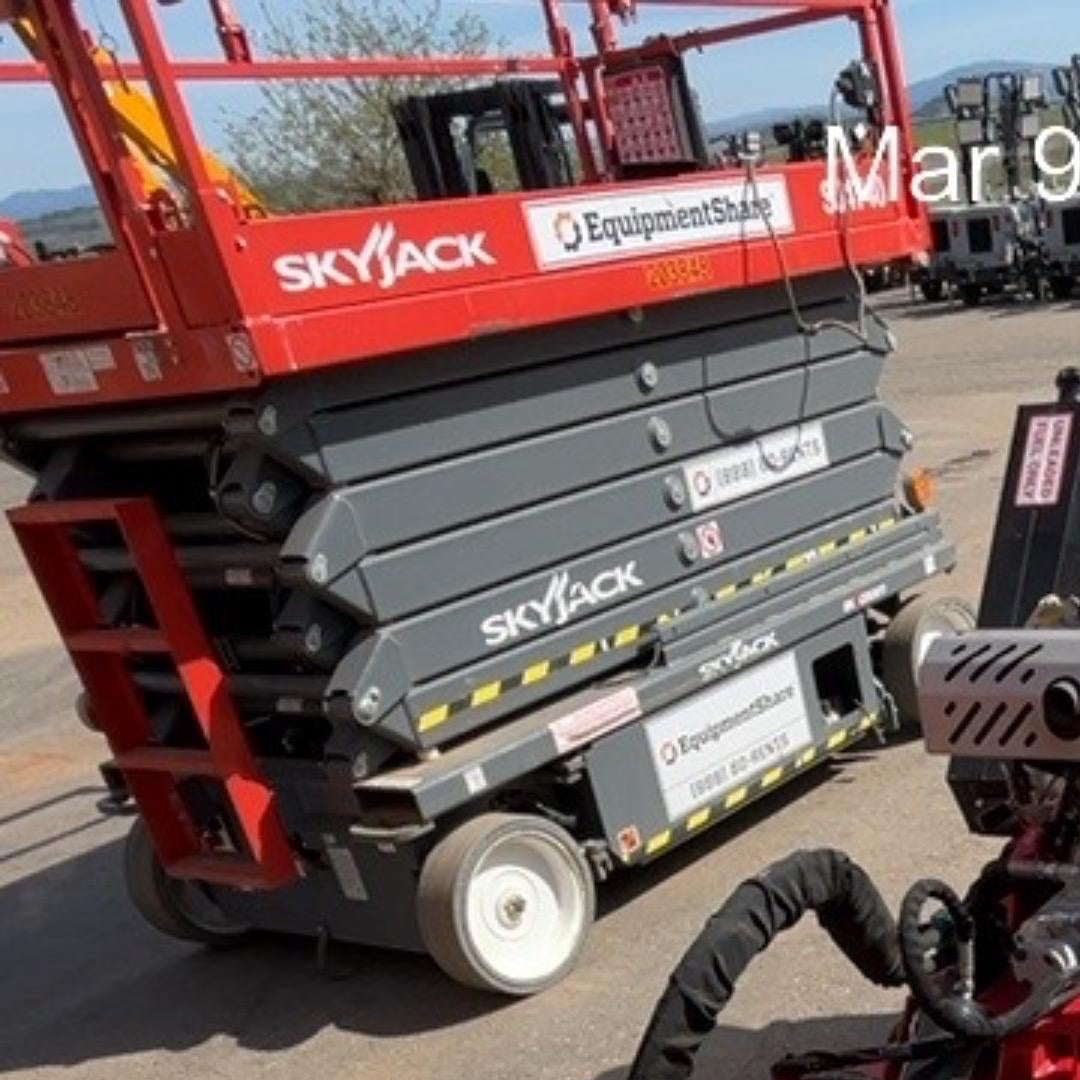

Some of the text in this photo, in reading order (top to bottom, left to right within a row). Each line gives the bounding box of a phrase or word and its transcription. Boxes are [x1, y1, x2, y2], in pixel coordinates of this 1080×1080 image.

[273, 221, 497, 293] SKYJACK
[582, 196, 774, 247] EquipmentShare
[1041, 418, 1067, 499] UNLEADED
[480, 560, 645, 647] SKYJACK
[677, 685, 795, 754] EquipmentShare
